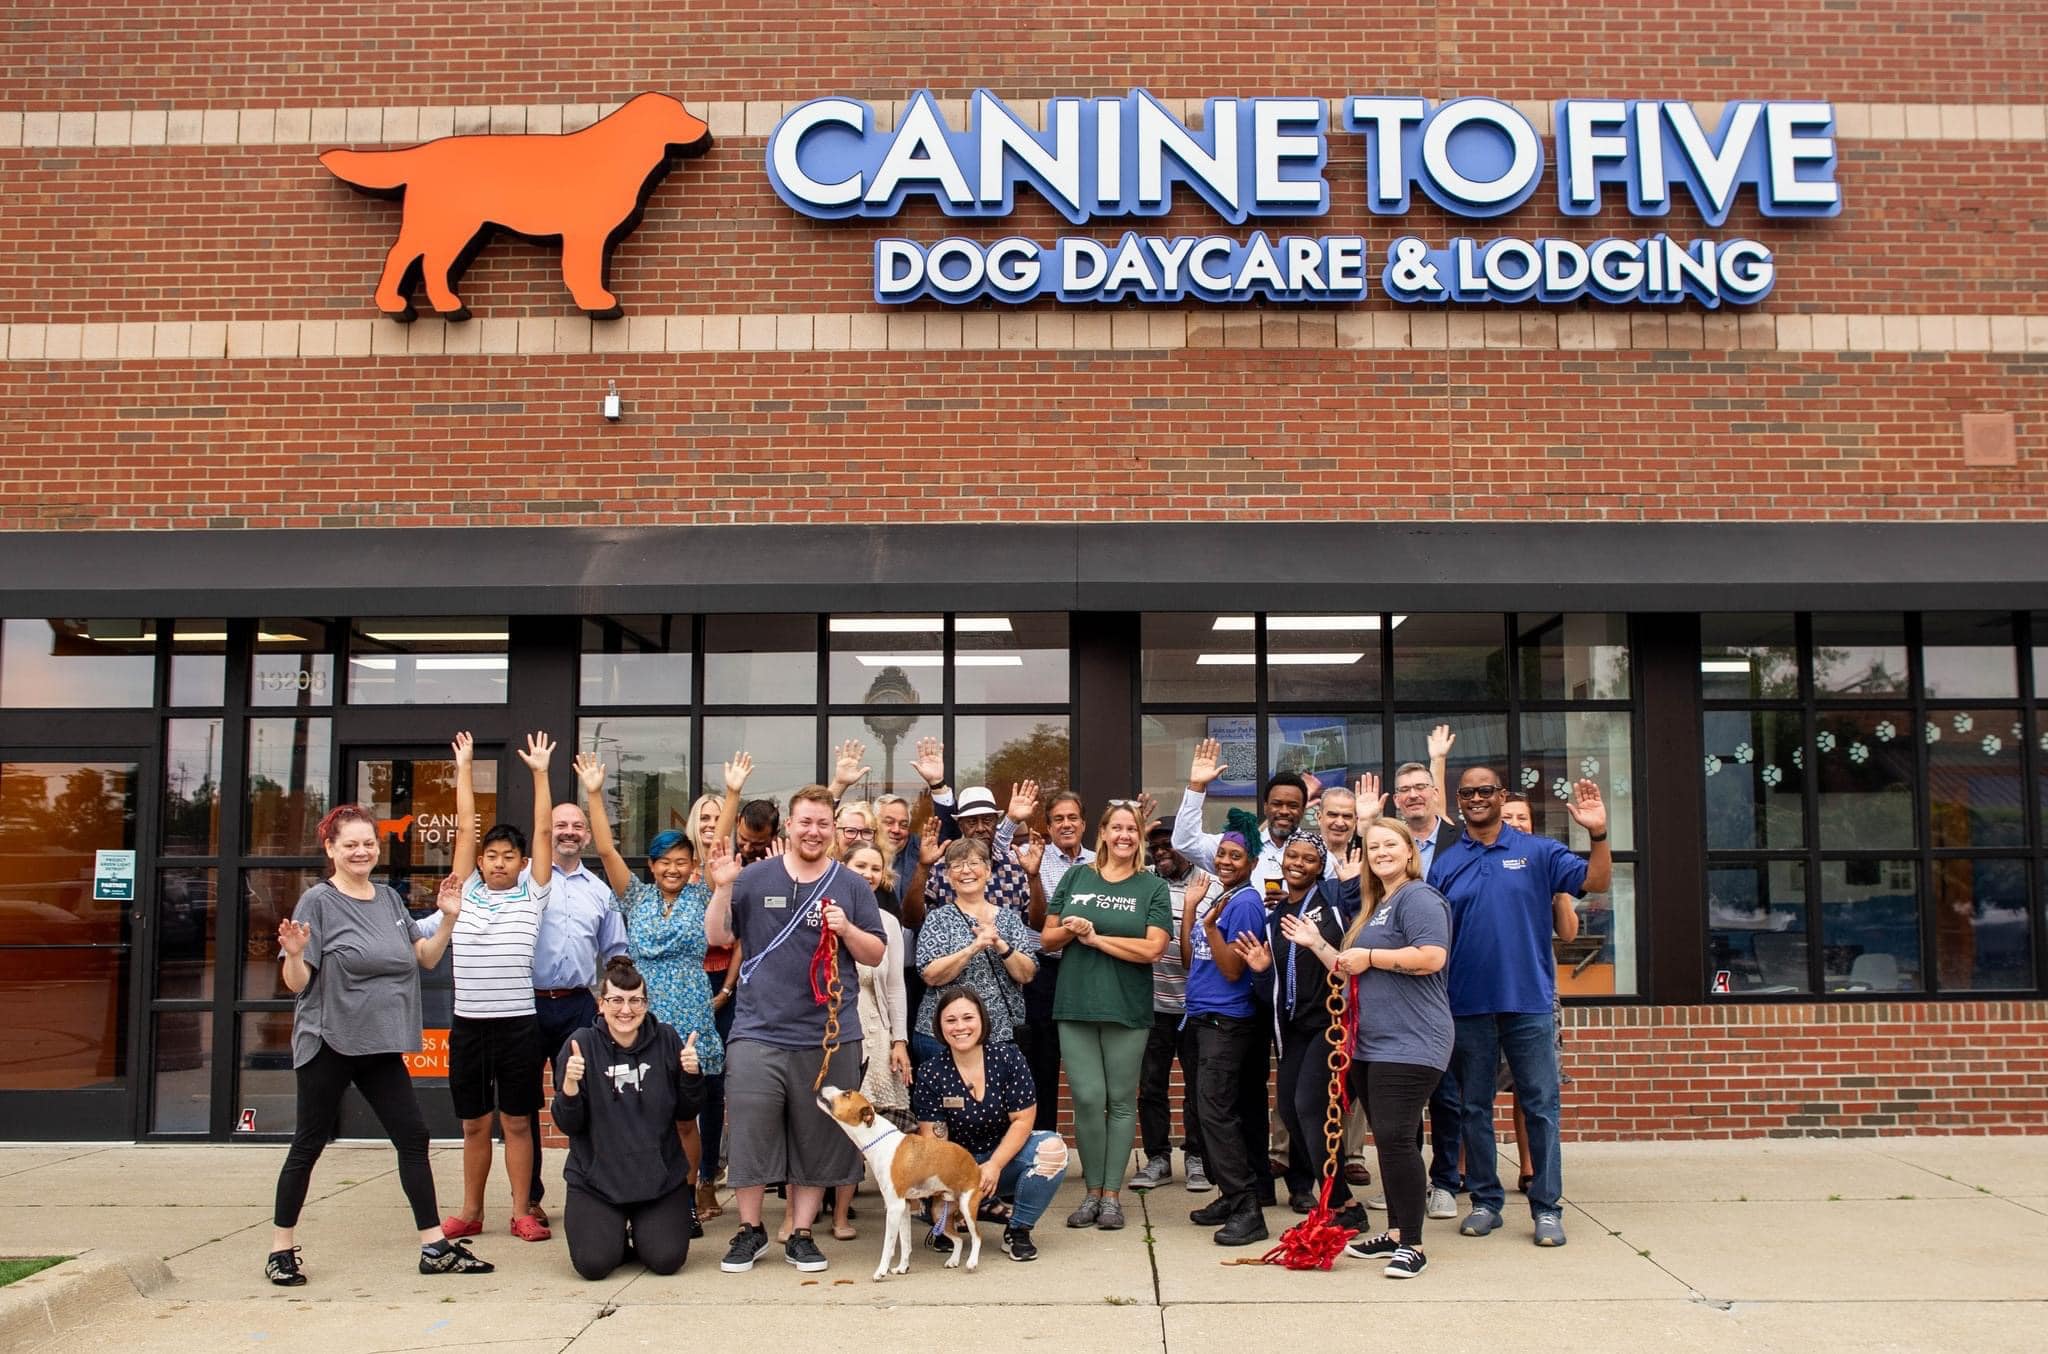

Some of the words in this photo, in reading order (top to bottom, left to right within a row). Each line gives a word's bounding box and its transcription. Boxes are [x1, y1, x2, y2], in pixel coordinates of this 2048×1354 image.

[773, 91, 1322, 210] CANINE
[1353, 98, 1539, 204] TO
[1567, 101, 1839, 209] FIVE
[878, 238, 1042, 293] DOG
[1062, 234, 1364, 291] DAYCARE
[1391, 237, 1444, 291] &
[1458, 235, 1774, 296] LODGING
[417, 814, 481, 827] CANIE
[419, 830, 441, 843] TO
[1096, 900, 1110, 909] TO
[1113, 904, 1136, 912] FIVE
[1097, 895, 1136, 905] CANINE
[806, 919, 818, 927] TO
[413, 1055, 438, 1068] ON
